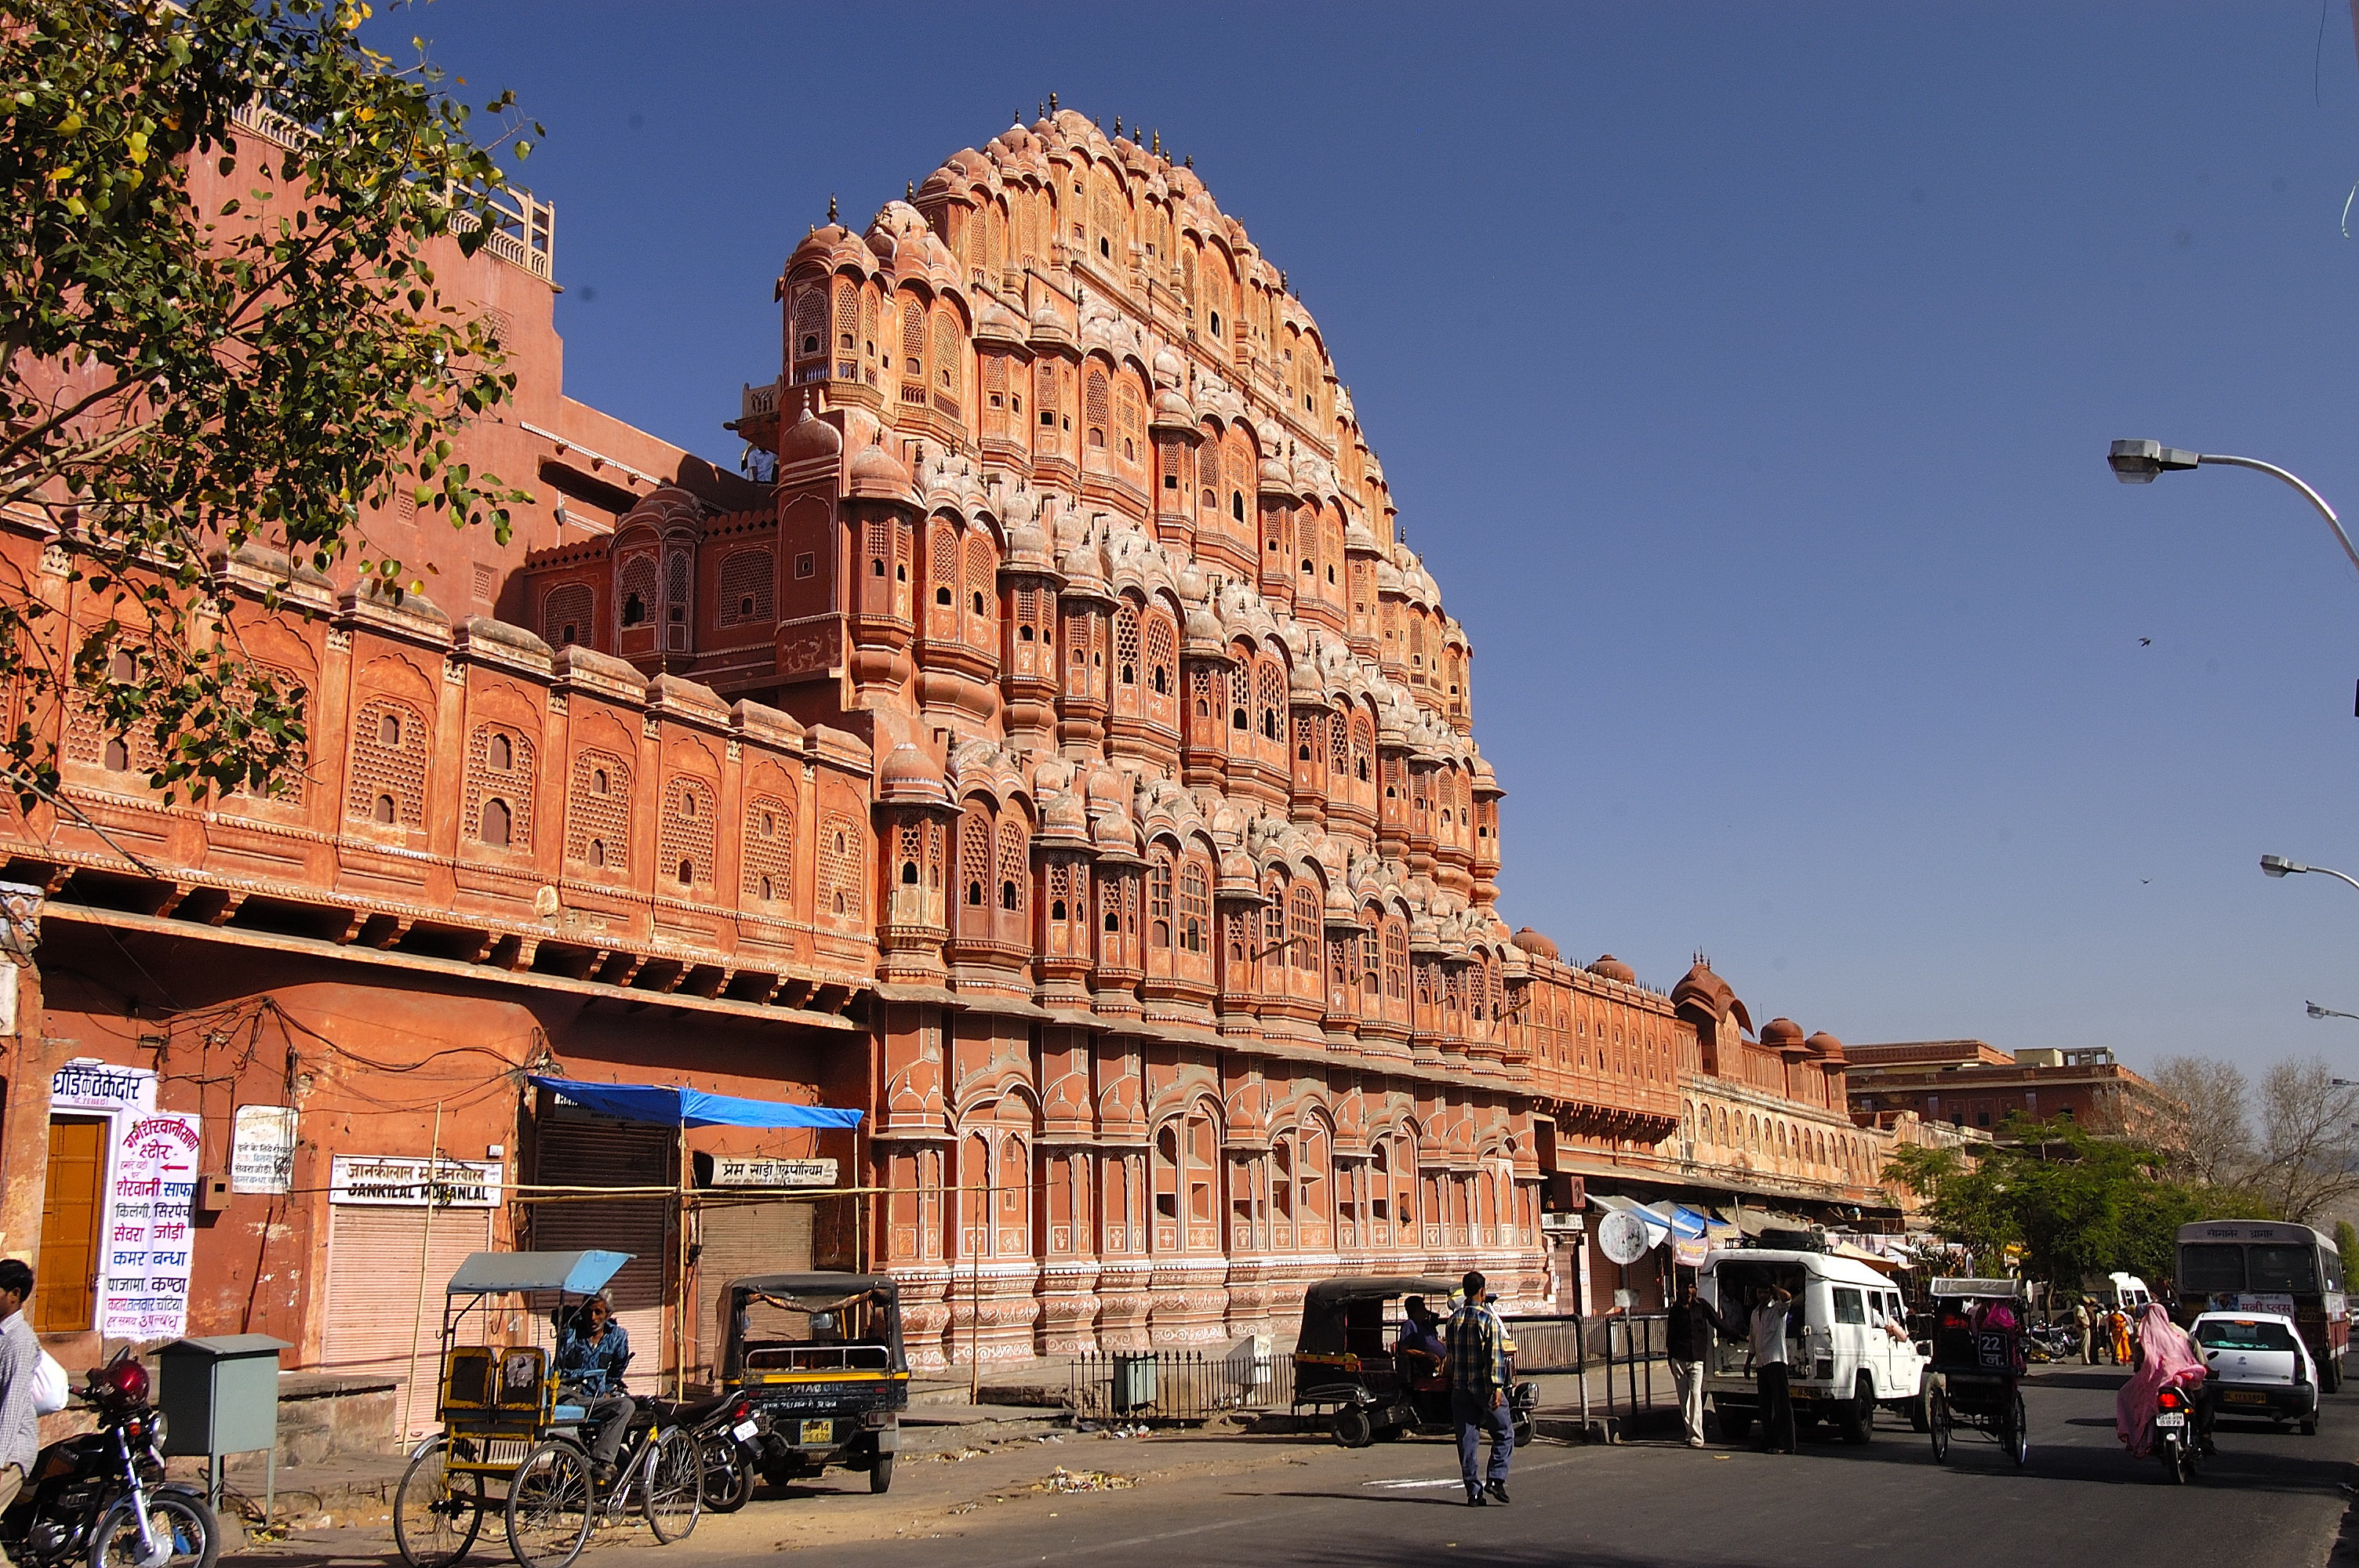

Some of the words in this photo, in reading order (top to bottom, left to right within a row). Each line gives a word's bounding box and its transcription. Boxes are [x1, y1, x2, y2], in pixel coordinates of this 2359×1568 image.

[140, 1139, 173, 1160] स्टोर
[347, 1158, 415, 1183] जानकीलाल
[722, 1160, 745, 1177] प्रेम
[347, 1182, 415, 1200] JANKILAL
[420, 1184, 489, 1201] MOHANLAL
[154, 1202, 193, 1218] सिरपेच
[114, 1223, 144, 1242] सेवरा
[154, 1221, 186, 1242] जोड़ी
[113, 1251, 148, 1265] कमर
[152, 1251, 187, 1266] बन्धा
[1979, 1280, 1999, 1290] 22
[2241, 1300, 2263, 1312] मनी
[2266, 1303, 2291, 1313] प्लस
[1981, 1336, 2001, 1351] 22
